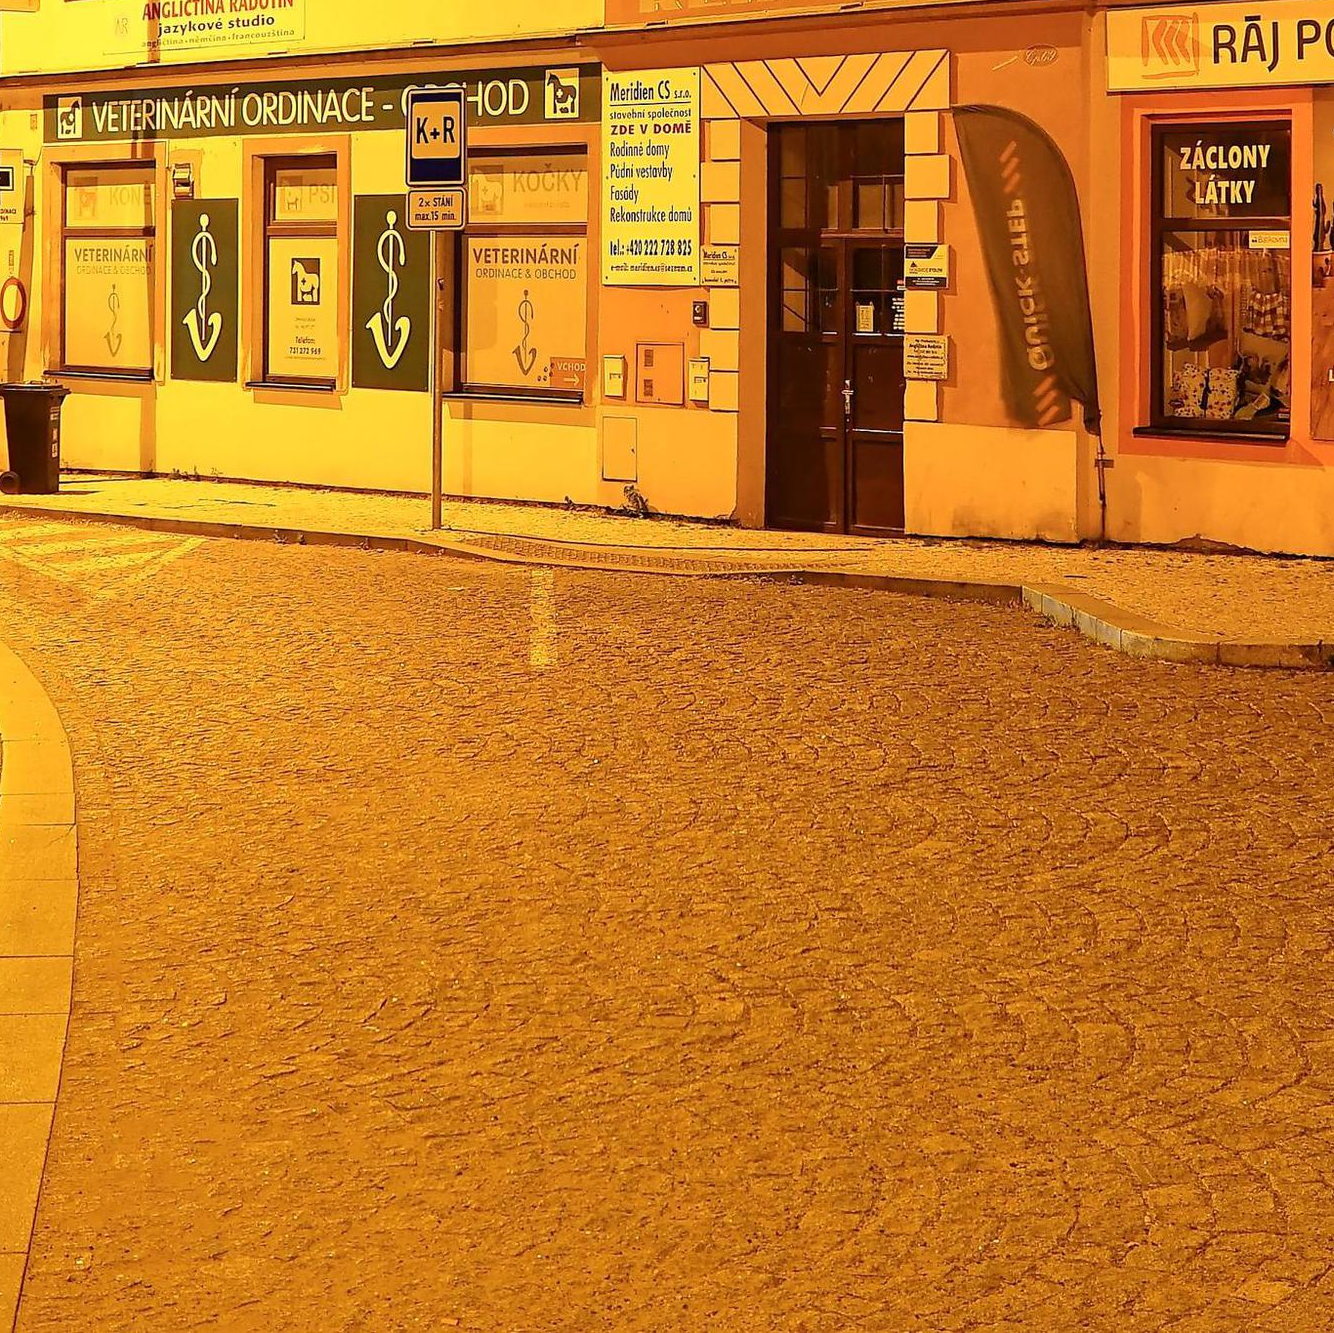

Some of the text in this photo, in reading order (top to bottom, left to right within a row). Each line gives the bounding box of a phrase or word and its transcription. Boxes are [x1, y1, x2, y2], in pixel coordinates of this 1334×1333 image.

[158, 14, 275, 38] jazykové studio
[609, 79, 692, 102] Meridien CS s.r.o.
[92, 86, 239, 134] VETERINÁRNÍ
[242, 85, 375, 127] ORDINACE
[609, 107, 692, 120] stavební společnost
[415, 115, 456, 144] K+R
[610, 119, 692, 136] ZDE V DOMĚ
[609, 138, 670, 159] Rodinné domy
[1179, 140, 1271, 172] ZÁCLONY
[512, 163, 583, 194] KOČKY
[635, 163, 673, 181] vestavby
[609, 185, 639, 204] Fasády
[1194, 175, 1256, 205] LÁTKY
[432, 195, 453, 207] STÁNÍ
[440, 210, 457, 221] min.
[609, 204, 692, 223] Rekonstrukce domů
[74, 242, 154, 263] VETERINÁRNÍ
[472, 243, 580, 265] VETERINÁRNÍ
[643, 239, 659, 255] 222
[660, 239, 675, 255] 728
[677, 238, 692, 256] 825
[475, 267, 577, 280] ORDINACE & OBCHOD
[556, 362, 587, 372] VCHOD
